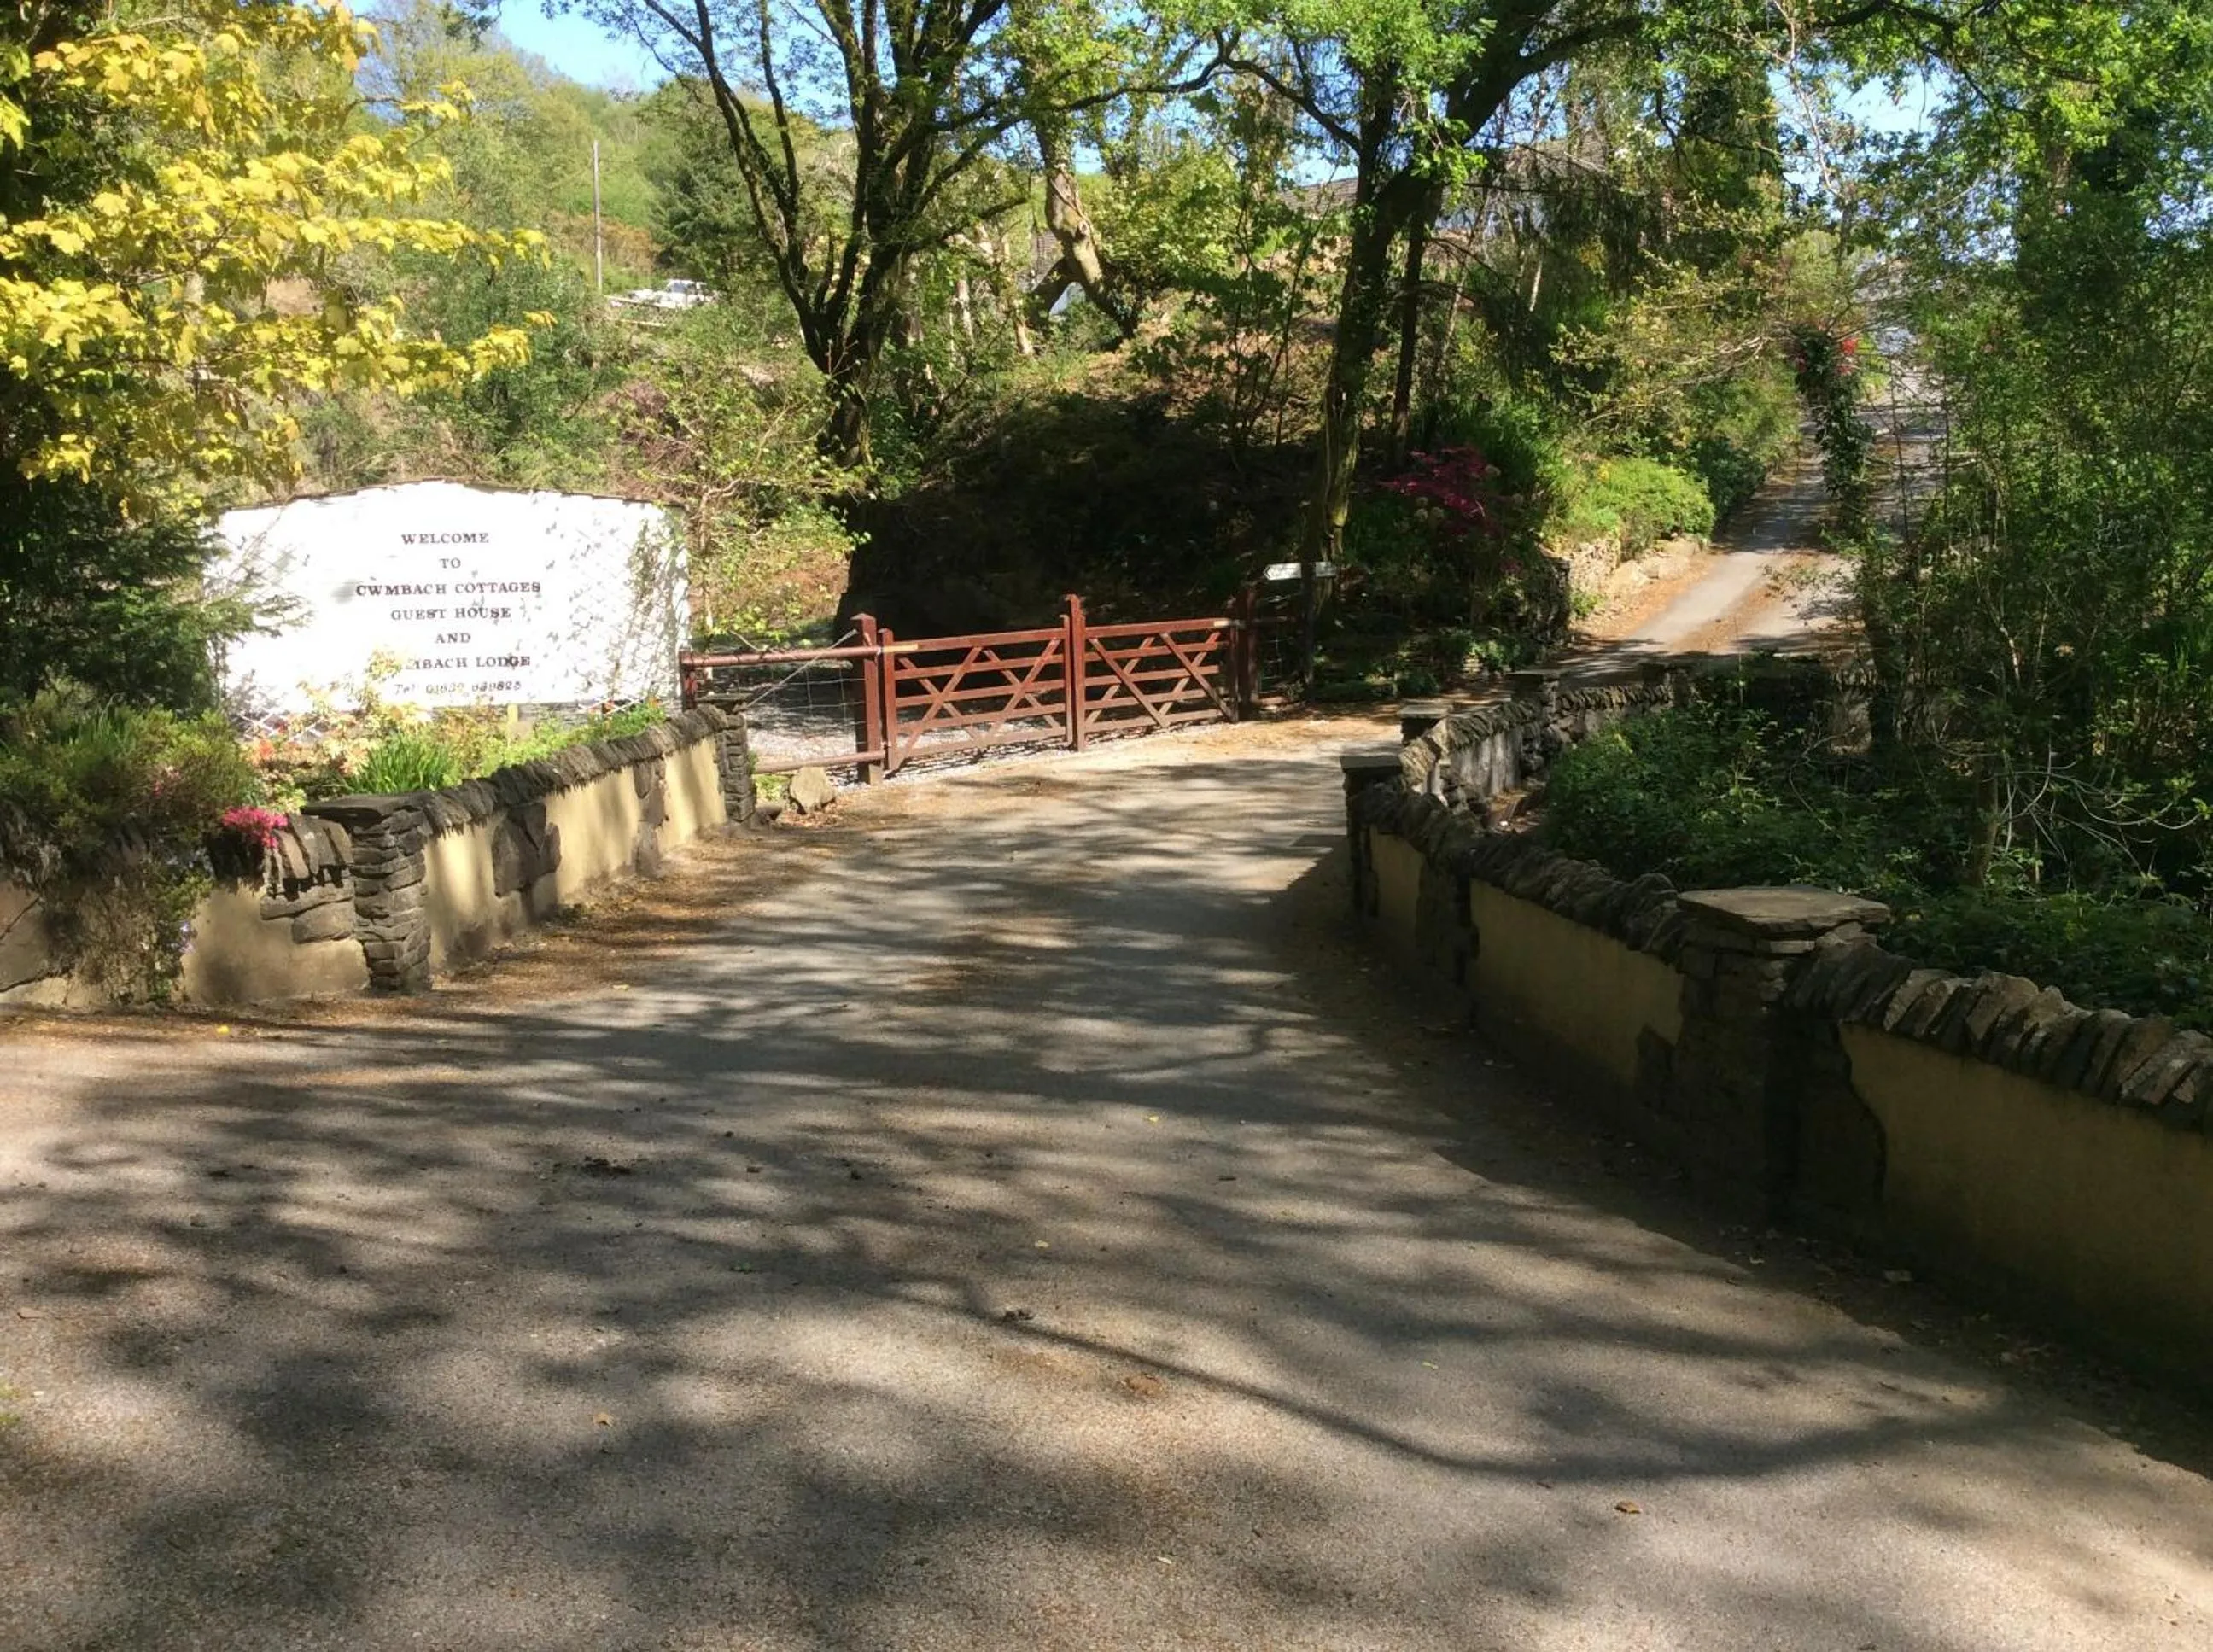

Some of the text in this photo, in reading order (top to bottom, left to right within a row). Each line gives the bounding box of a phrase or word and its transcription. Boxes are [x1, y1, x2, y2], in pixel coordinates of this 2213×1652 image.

[401, 533, 489, 545] WELCOME
[440, 557, 461, 569] TO
[356, 582, 541, 596] CWMBACH COTTAGES
[391, 608, 511, 621] GUEST HOUSE
[435, 633, 471, 644] AND
[476, 657, 530, 668] LODGE
